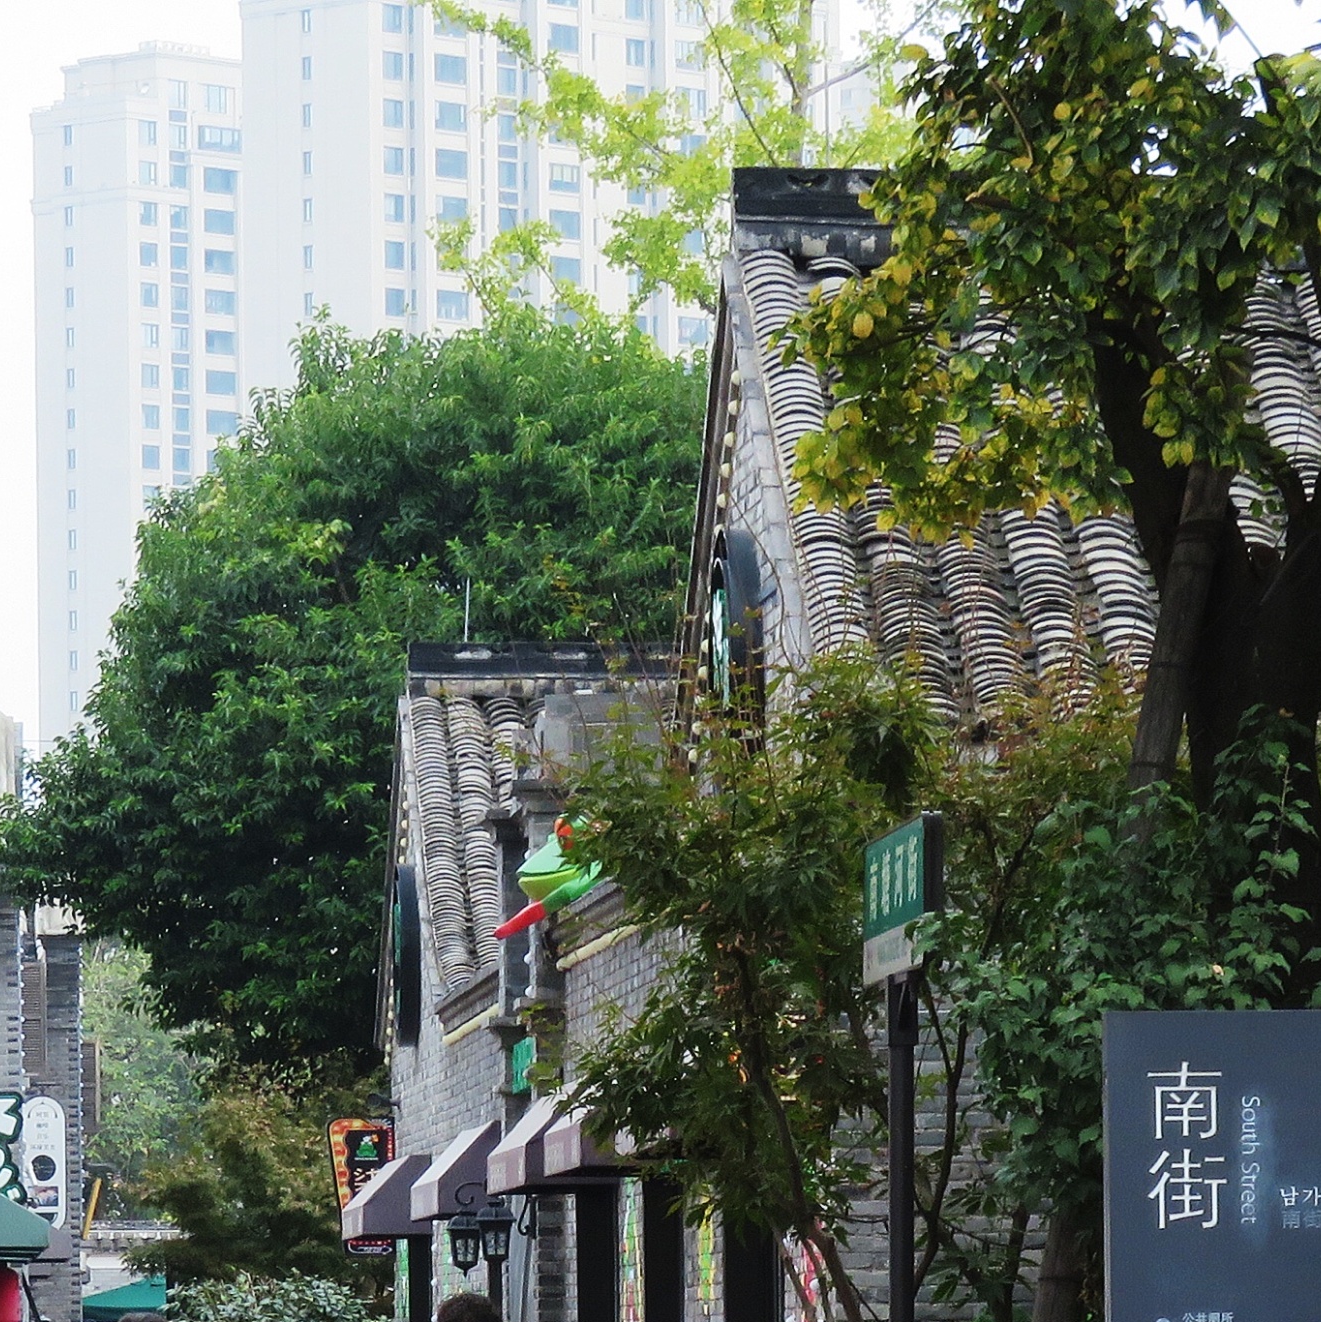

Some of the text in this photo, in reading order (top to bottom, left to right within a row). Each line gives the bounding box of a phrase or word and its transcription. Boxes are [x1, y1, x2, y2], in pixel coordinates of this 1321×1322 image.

[1146, 1061, 1227, 1229] 南街
[1240, 1094, 1261, 1225] South Street
[1280, 1185, 1321, 1208] 남가
